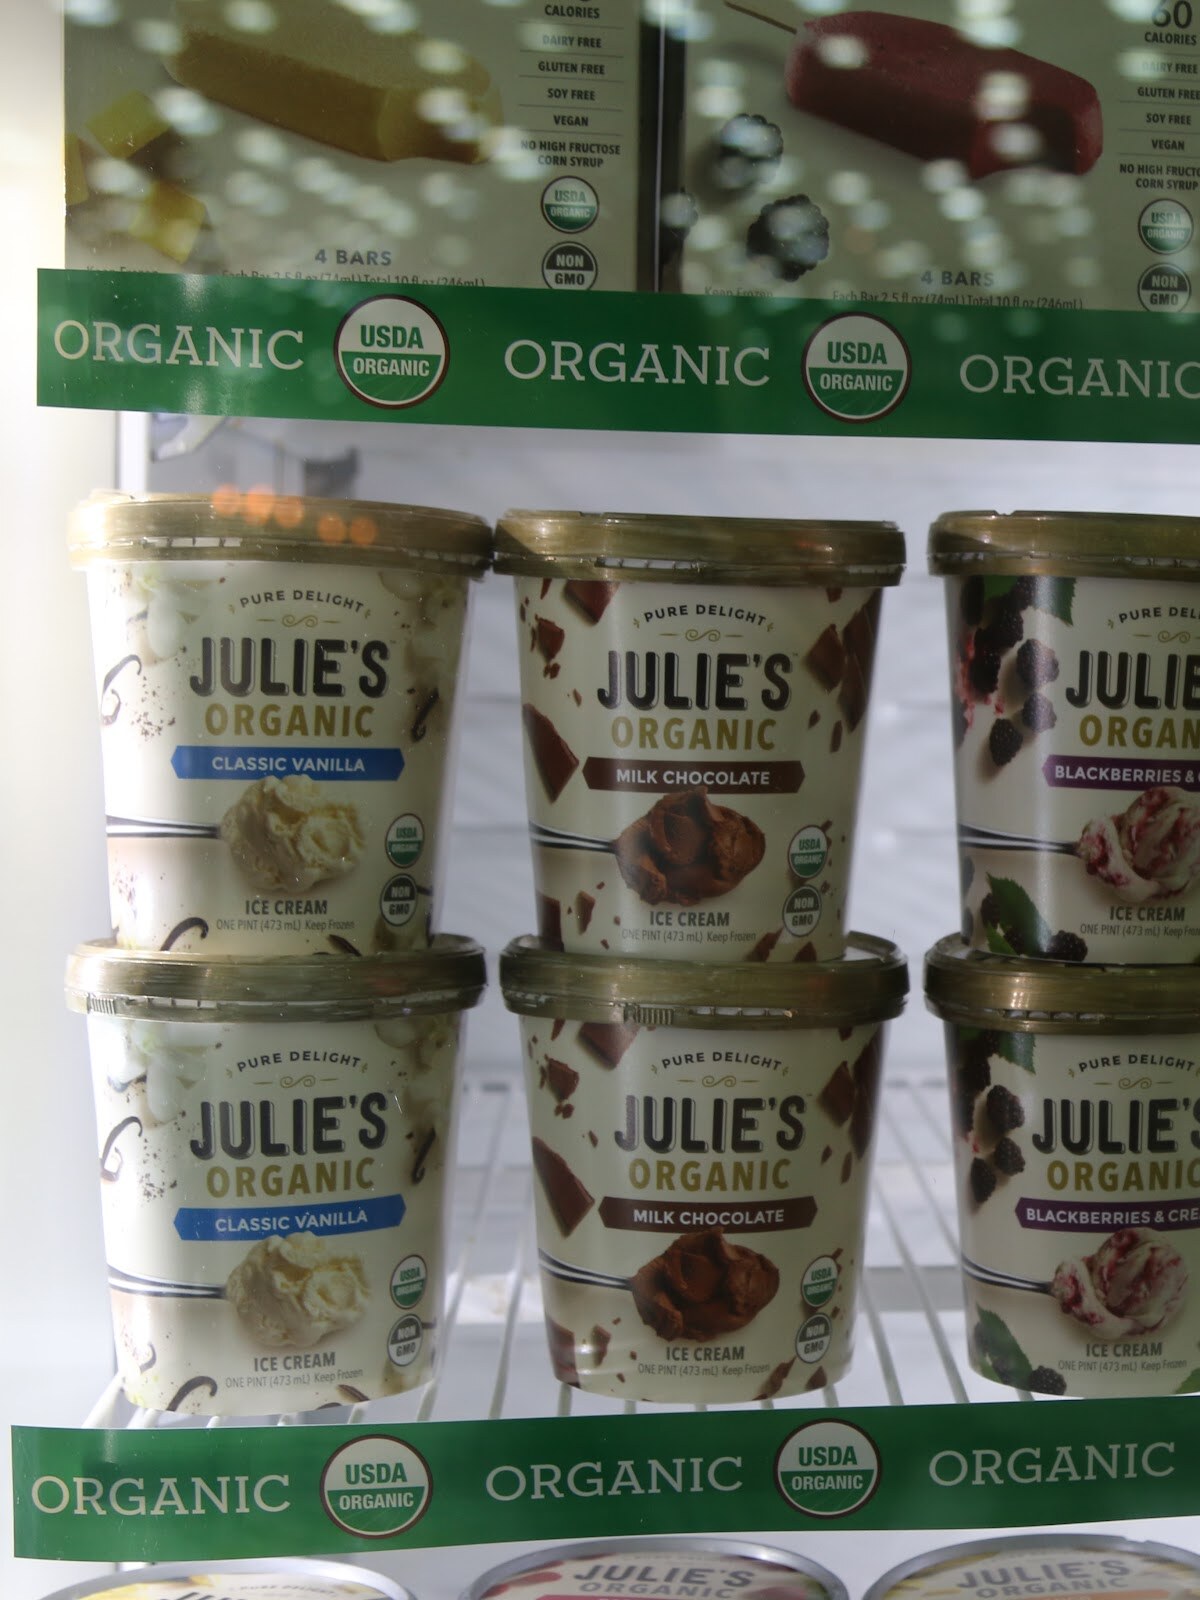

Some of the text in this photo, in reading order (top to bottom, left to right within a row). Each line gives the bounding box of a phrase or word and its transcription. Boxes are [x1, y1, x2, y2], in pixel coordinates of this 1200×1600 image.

[545, 5, 600, 19] CALORIES
[1151, 0, 1192, 29] 60
[1144, 32, 1197, 46] CALORIES
[538, 61, 605, 75] GLUTEN FREE
[548, 88, 595, 101] SOY FREE
[1137, 87, 1200, 101] GLUTEN FREE
[553, 115, 589, 126] VEGAN
[1146, 113, 1191, 126] SOY FREE
[540, 141, 565, 152] HIGH
[569, 143, 621, 155] FRUCTOSE
[1152, 139, 1185, 151] VEGAN
[538, 155, 604, 167] CORN SYRUP
[555, 190, 586, 202] USDA
[551, 206, 590, 218] ORGANIC
[315, 248, 392, 266] 4 BARS
[556, 254, 584, 267] NON
[555, 273, 585, 286] GMO
[1152, 275, 1178, 288] NON
[1150, 293, 1179, 306] GMO
[54, 319, 304, 371] ORGANIC
[360, 325, 423, 350] USDA
[827, 340, 887, 365] USDA
[352, 355, 430, 378] ORGANIC
[505, 339, 770, 387] ORGANIC
[820, 372, 893, 392] ORGANIC
[240, 590, 364, 613] PURE DELIGHT
[644, 604, 767, 627] PURE DELIGHT
[1119, 607, 1162, 624] PURE
[190, 637, 391, 698] JULIE'S
[597, 651, 792, 711] JULIE'S
[205, 703, 374, 738] ORGANIC
[612, 716, 776, 751] ORGANIC
[212, 756, 365, 773] CLASSIC VANILLA
[616, 769, 770, 785] MILK CHOCOLATE
[1055, 765, 1182, 783] BLACKBERRIES
[1185, 771, 1194, 783] &
[246, 900, 328, 915] ICE CREAM
[1110, 906, 1185, 922] ICE CREAM
[650, 912, 730, 927] ICE CREAM
[237, 1051, 361, 1072] PURE DELIGHT
[662, 1051, 782, 1071] PURE DELIGHT
[1079, 1054, 1196, 1072] PURE DELIGHT
[190, 1092, 388, 1160] JULIE'S
[614, 1095, 806, 1153] JULIE'S
[206, 1157, 375, 1198] ORGANIC
[629, 1158, 791, 1192] ORGANIC
[215, 1210, 368, 1232] CLASSIC VANILLA
[633, 1209, 784, 1226] MILK CHOCOLATE
[1026, 1208, 1150, 1225] BLACKBERRIES
[1154, 1211, 1165, 1223] &
[666, 1346, 744, 1361] ICE CREAM
[1086, 1342, 1163, 1357] ICE CREAM
[254, 1352, 336, 1372] ICE CREAM
[798, 1446, 857, 1467] USDA
[929, 1442, 1175, 1487] ORGANIC
[345, 1462, 408, 1484] USDA
[485, 1456, 743, 1501] ORGANIC
[791, 1474, 863, 1491] ORGANIC
[31, 1474, 290, 1516] ORGANIC
[339, 1491, 414, 1510] ORGANIC
[575, 1564, 755, 1587] JULIE'S
[956, 1559, 1132, 1589] JULIE'S
[579, 1583, 736, 1599] ORGANIC
[976, 1577, 1131, 1599] ORGANIC
